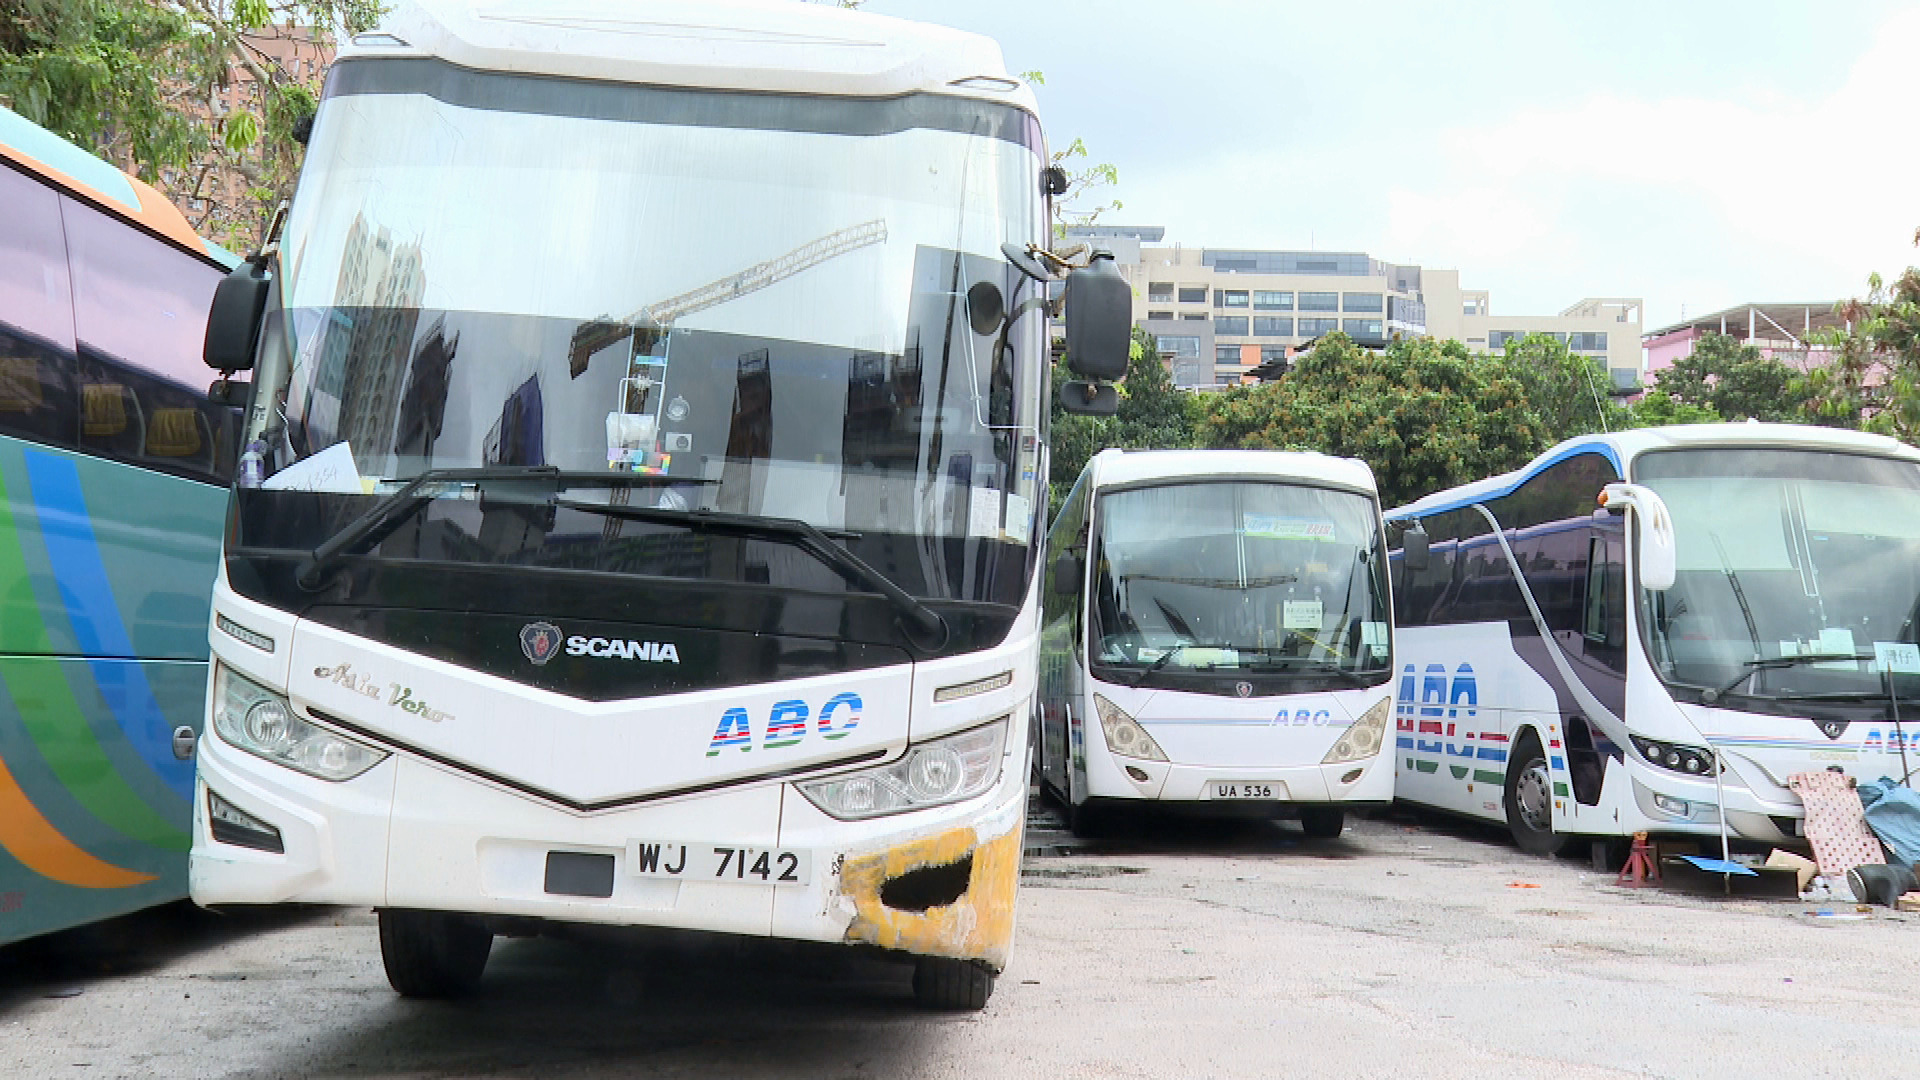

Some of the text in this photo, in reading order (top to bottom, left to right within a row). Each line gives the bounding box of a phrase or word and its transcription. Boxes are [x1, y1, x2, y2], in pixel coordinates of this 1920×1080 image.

[565, 635, 680, 664] SCANIA
[705, 691, 864, 757] ABC
[1271, 708, 1330, 727] ABC
[1218, 785, 1271, 797] UA 536
[639, 843, 800, 881] WJ 7142
